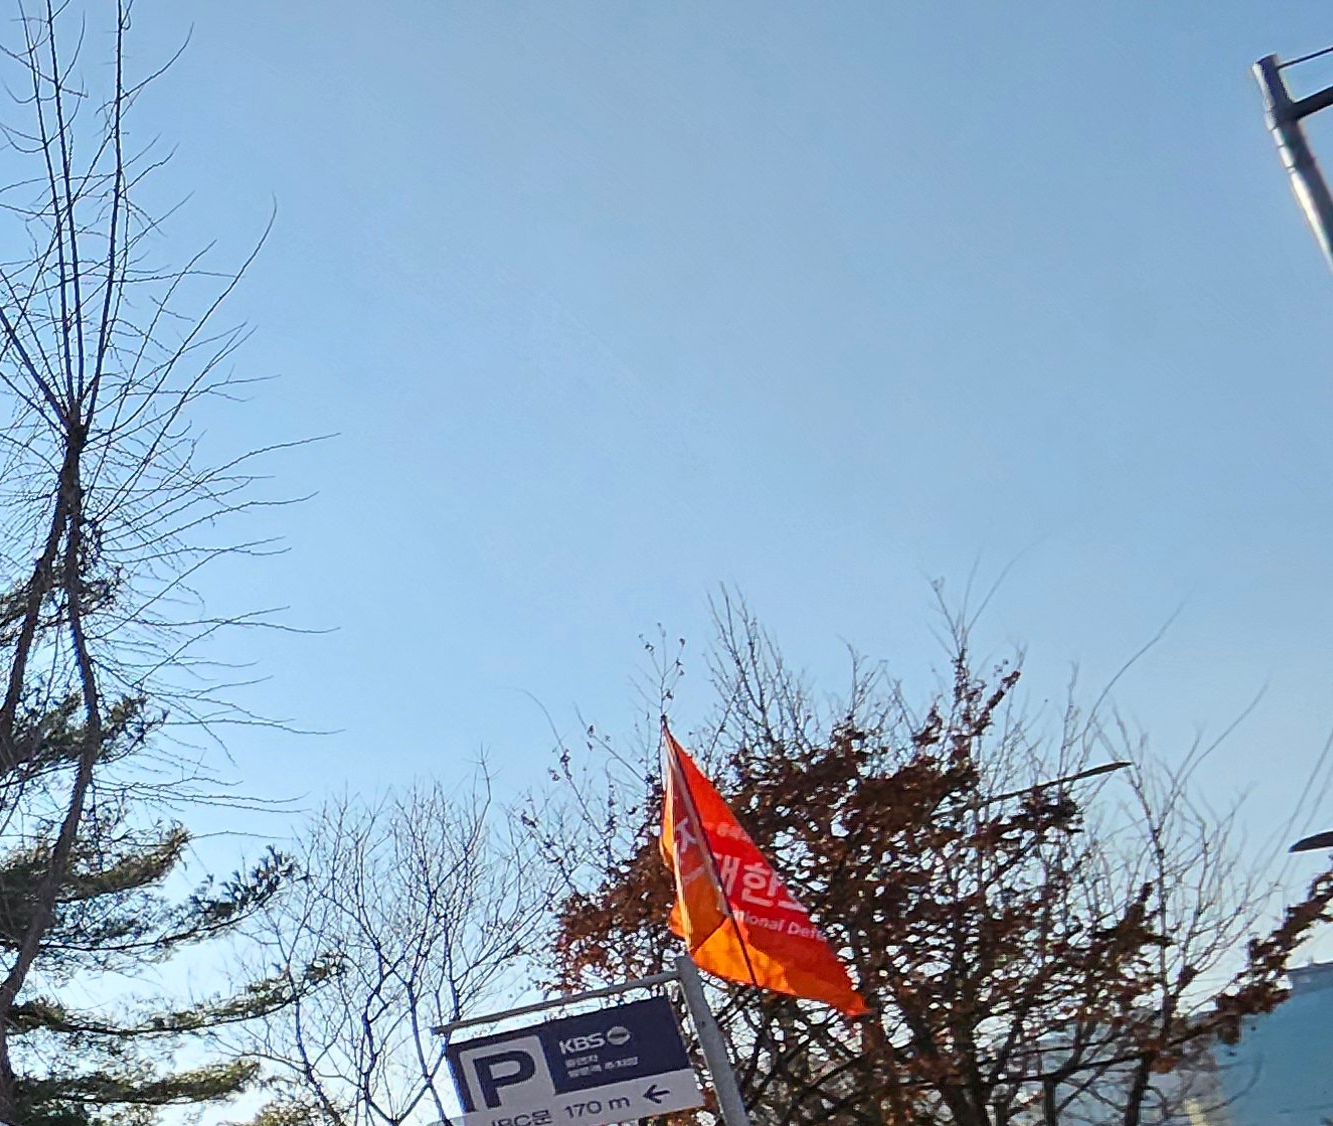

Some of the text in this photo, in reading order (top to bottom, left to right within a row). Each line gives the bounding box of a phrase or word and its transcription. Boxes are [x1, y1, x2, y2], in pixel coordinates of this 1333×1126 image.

[559, 1033, 605, 1054] KBS
[473, 1050, 536, 1109] P
[564, 1099, 602, 1120] 170
[609, 1095, 631, 1111] m
